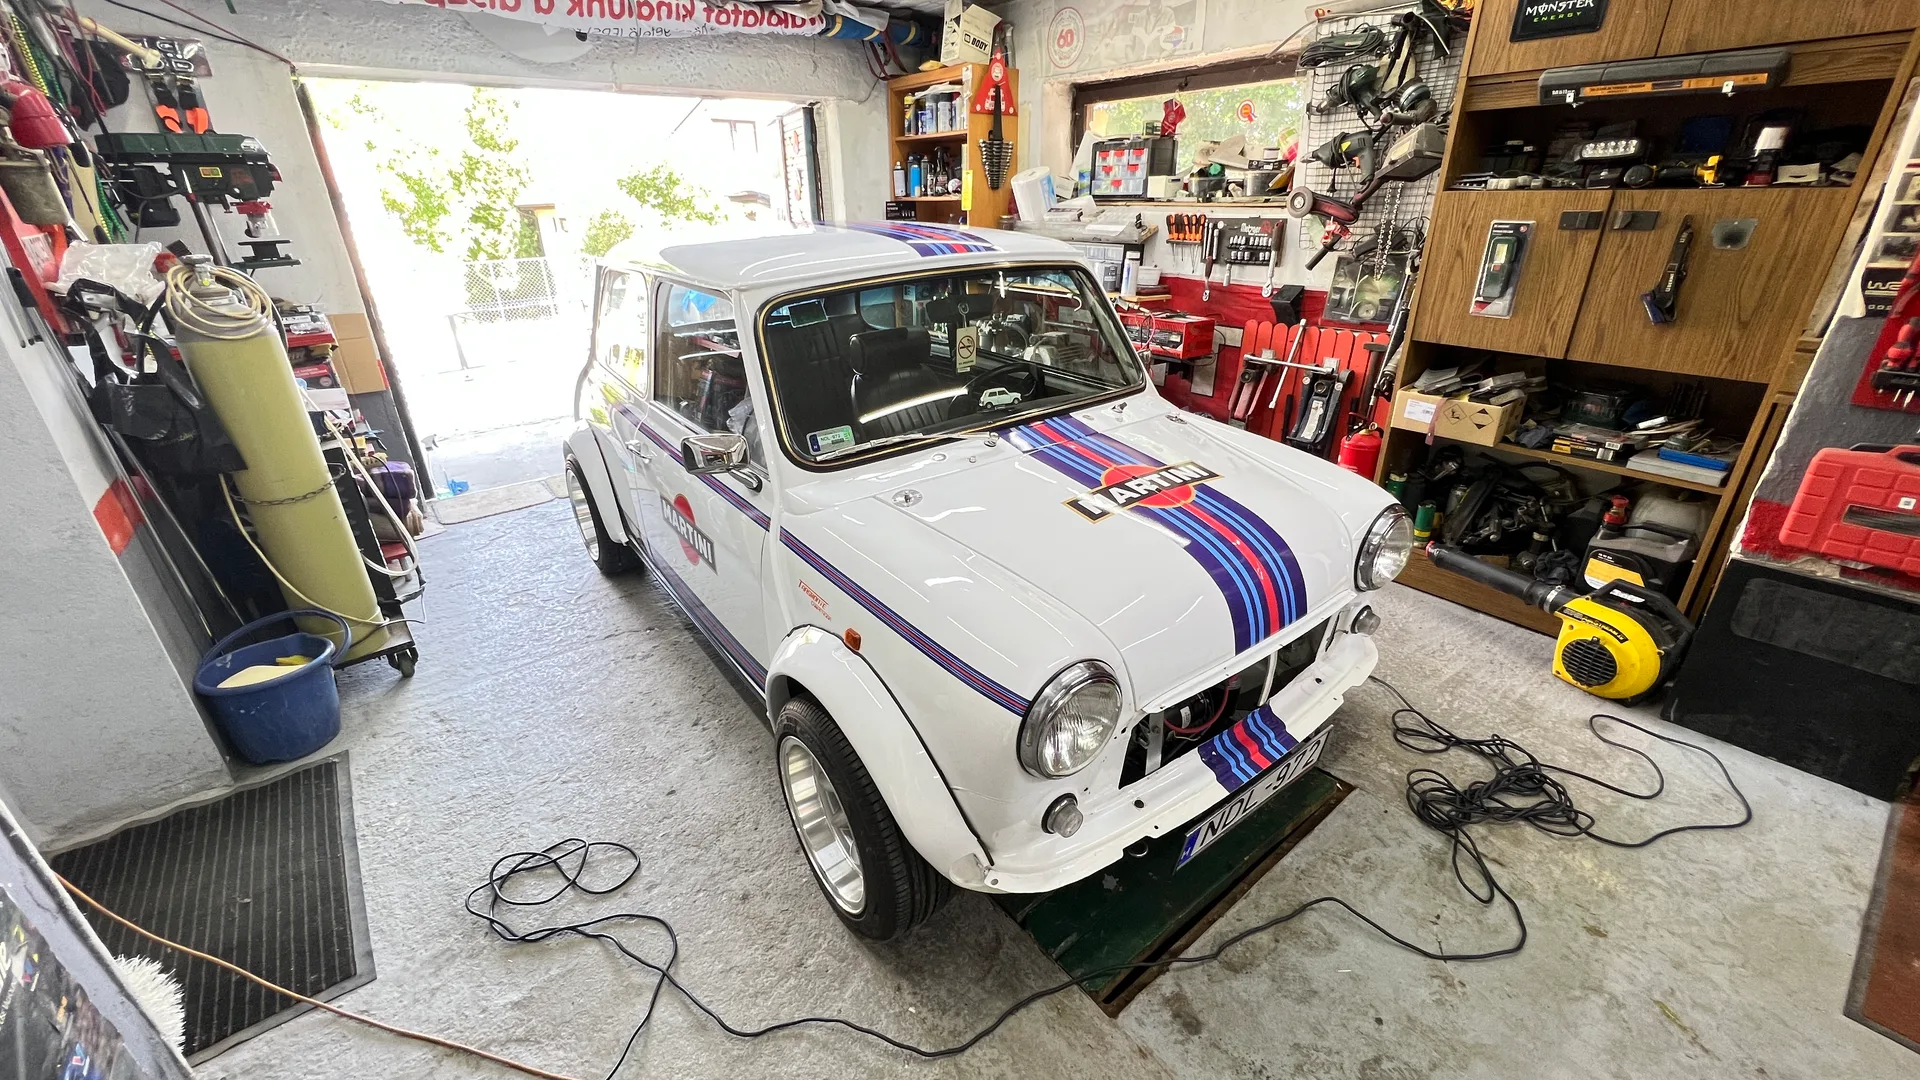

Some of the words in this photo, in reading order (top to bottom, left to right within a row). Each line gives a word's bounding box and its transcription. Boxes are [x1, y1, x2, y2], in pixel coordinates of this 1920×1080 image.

[1534, 11, 1582, 23] ENERGY
[971, 37, 988, 52] BODY
[1057, 28, 1075, 49] 60
[1078, 464, 1210, 515] MARTINI
[662, 499, 713, 564] MARTINI
